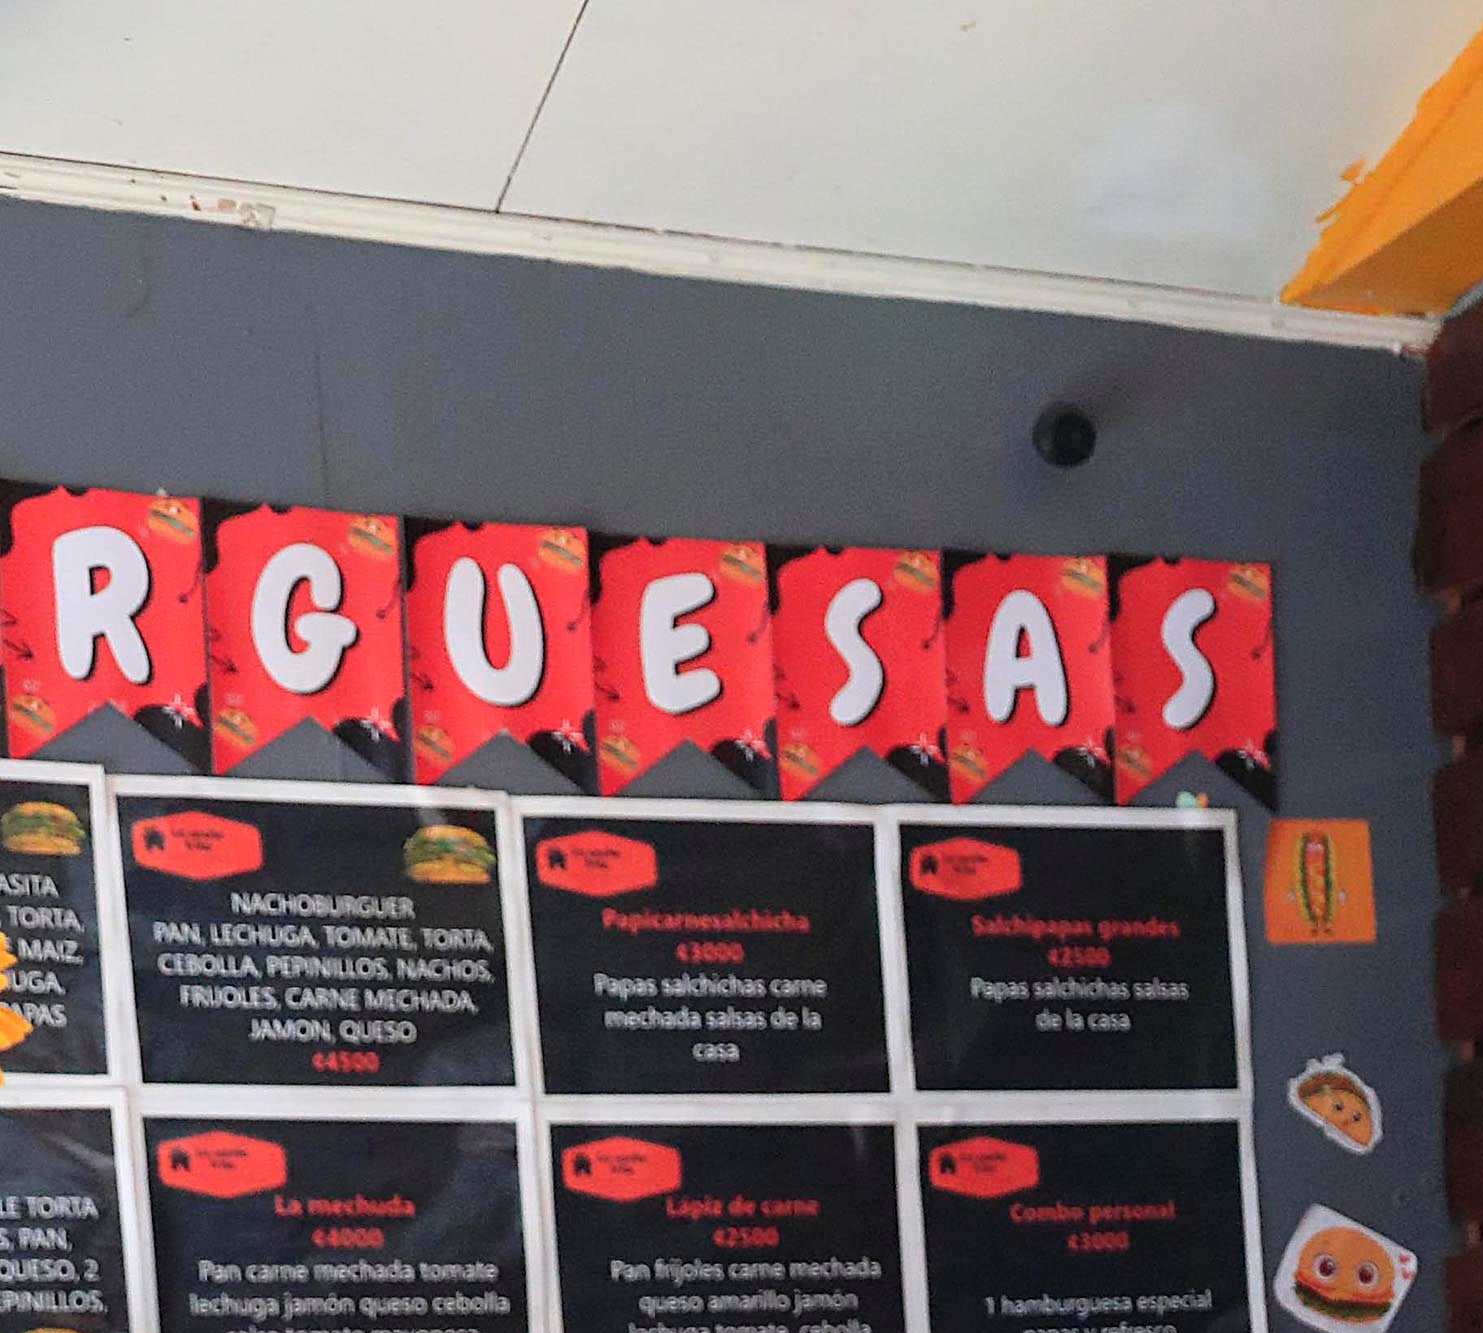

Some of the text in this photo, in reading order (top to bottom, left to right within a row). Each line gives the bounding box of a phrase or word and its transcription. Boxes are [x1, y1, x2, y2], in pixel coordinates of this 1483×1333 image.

[230, 893, 415, 919] NACHOBURGUER
[284, 987, 361, 1011] CARNE
[593, 972, 828, 1001] Papas salchichas carne
[970, 976, 1190, 1003] Papas salchichas salsas
[604, 1005, 822, 1031] mechada salsas de la
[1035, 1008, 1132, 1032] de la casa
[339, 1020, 417, 1044] QUESO
[692, 1042, 741, 1063] casa
[25, 1196, 99, 1220] TORTA
[84, 1258, 100, 1282] 2
[199, 1259, 500, 1284] Pan carne mechada tomate
[610, 1256, 882, 1287] Pan frijoles carne mechada
[189, 1293, 280, 1323] lechuga
[358, 1296, 429, 1321] queso
[432, 1291, 512, 1316] cebolla
[639, 1289, 791, 1319] queso amarillo
[985, 1289, 1213, 1319] 1 hamburguesa especial
